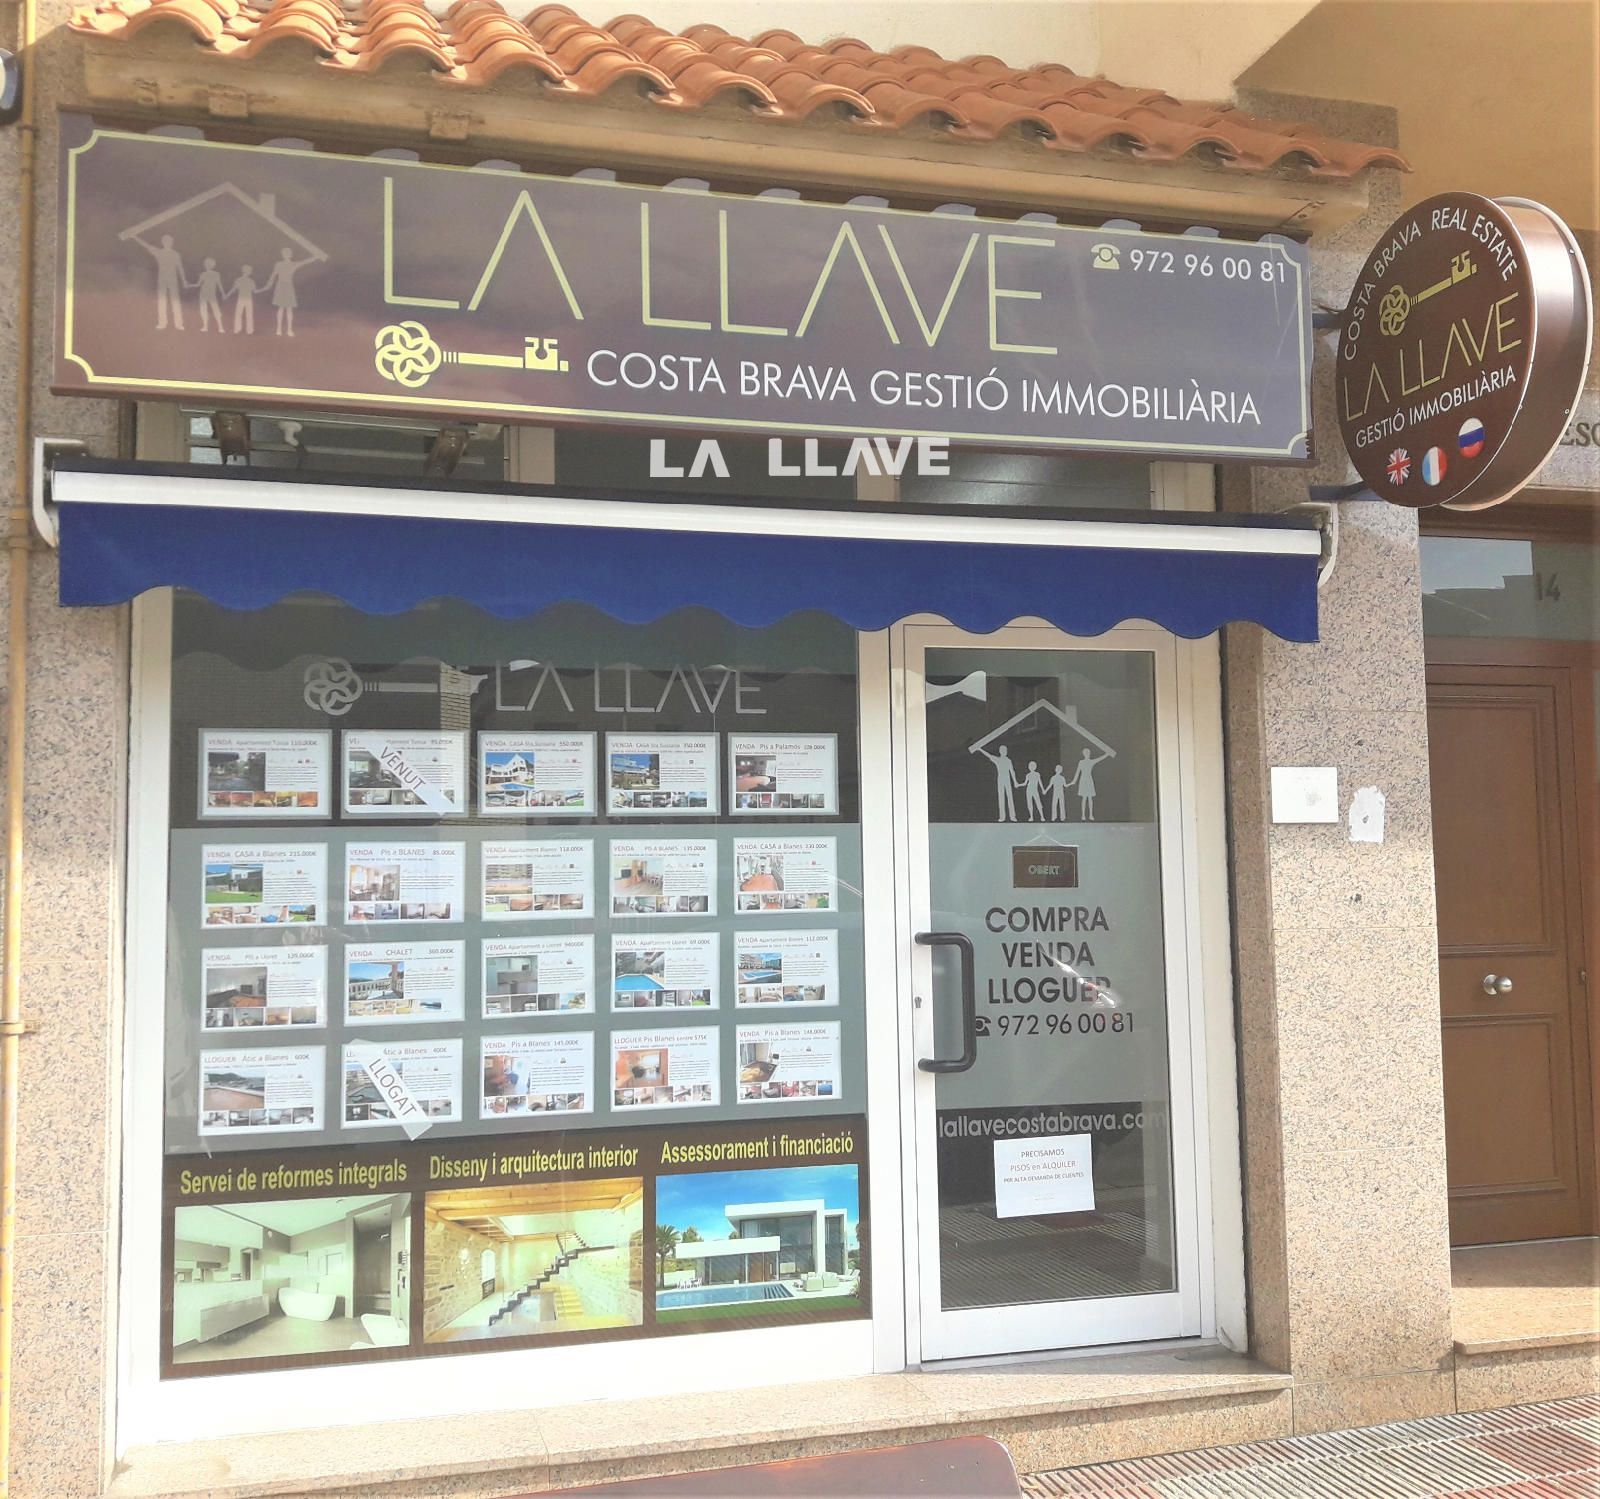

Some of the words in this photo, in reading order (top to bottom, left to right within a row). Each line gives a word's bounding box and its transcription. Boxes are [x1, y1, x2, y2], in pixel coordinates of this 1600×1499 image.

[382, 176, 584, 321] LA
[640, 201, 1058, 355] LLAVE
[1129, 249, 1175, 273] 972
[1184, 253, 1214, 277] 96
[1222, 257, 1252, 280] 00
[1260, 261, 1285, 283] 81
[1344, 282, 1376, 361] COSTA
[1373, 220, 1422, 279] BRAVA
[1431, 206, 1467, 232] REAL
[1471, 215, 1518, 282] ESTATE
[1344, 361, 1390, 422] LA
[1399, 291, 1522, 396] LLAVE
[586, 349, 726, 395] COSTA
[740, 360, 856, 402] BRAVA
[870, 367, 1009, 411] GESTIÓ
[1022, 379, 1262, 425] IMMOBILIÀRIA
[1355, 408, 1405, 449] GESTIÓ
[1409, 364, 1517, 426] IMMOBILIÀRIA
[1535, 572, 1562, 601] 14
[495, 660, 574, 713] LA
[594, 662, 768, 715] LLAVE
[380, 746, 427, 790] VENUT
[349, 848, 373, 856] VENDA
[1027, 864, 1061, 876] OBERT
[984, 906, 1110, 933] COMPRA
[385, 948, 413, 956] CHALET
[1001, 941, 1096, 968] VENDA
[997, 1014, 1040, 1037] 972
[1045, 1013, 1073, 1035] 96
[1077, 1012, 1106, 1034] 00
[1111, 1012, 1135, 1033] 81
[368, 1057, 418, 1116] LLOGAT
[938, 1110, 1166, 1138] lallavecostabrava.com
[429, 1154, 488, 1182] Disseny
[492, 1152, 497, 1175] i
[499, 1148, 586, 1179] arquitectura
[588, 1144, 639, 1169] interior
[660, 1137, 770, 1164] Assessorament
[780, 1131, 854, 1156] financiació
[1020, 1148, 1065, 1158] PRECISAMOS
[180, 1168, 232, 1195] Servei
[236, 1167, 257, 1191] de
[261, 1164, 334, 1190] reformes
[338, 1158, 408, 1189] integrals
[1010, 1163, 1031, 1172] PISOS
[1042, 1160, 1076, 1170] ALQUILER
